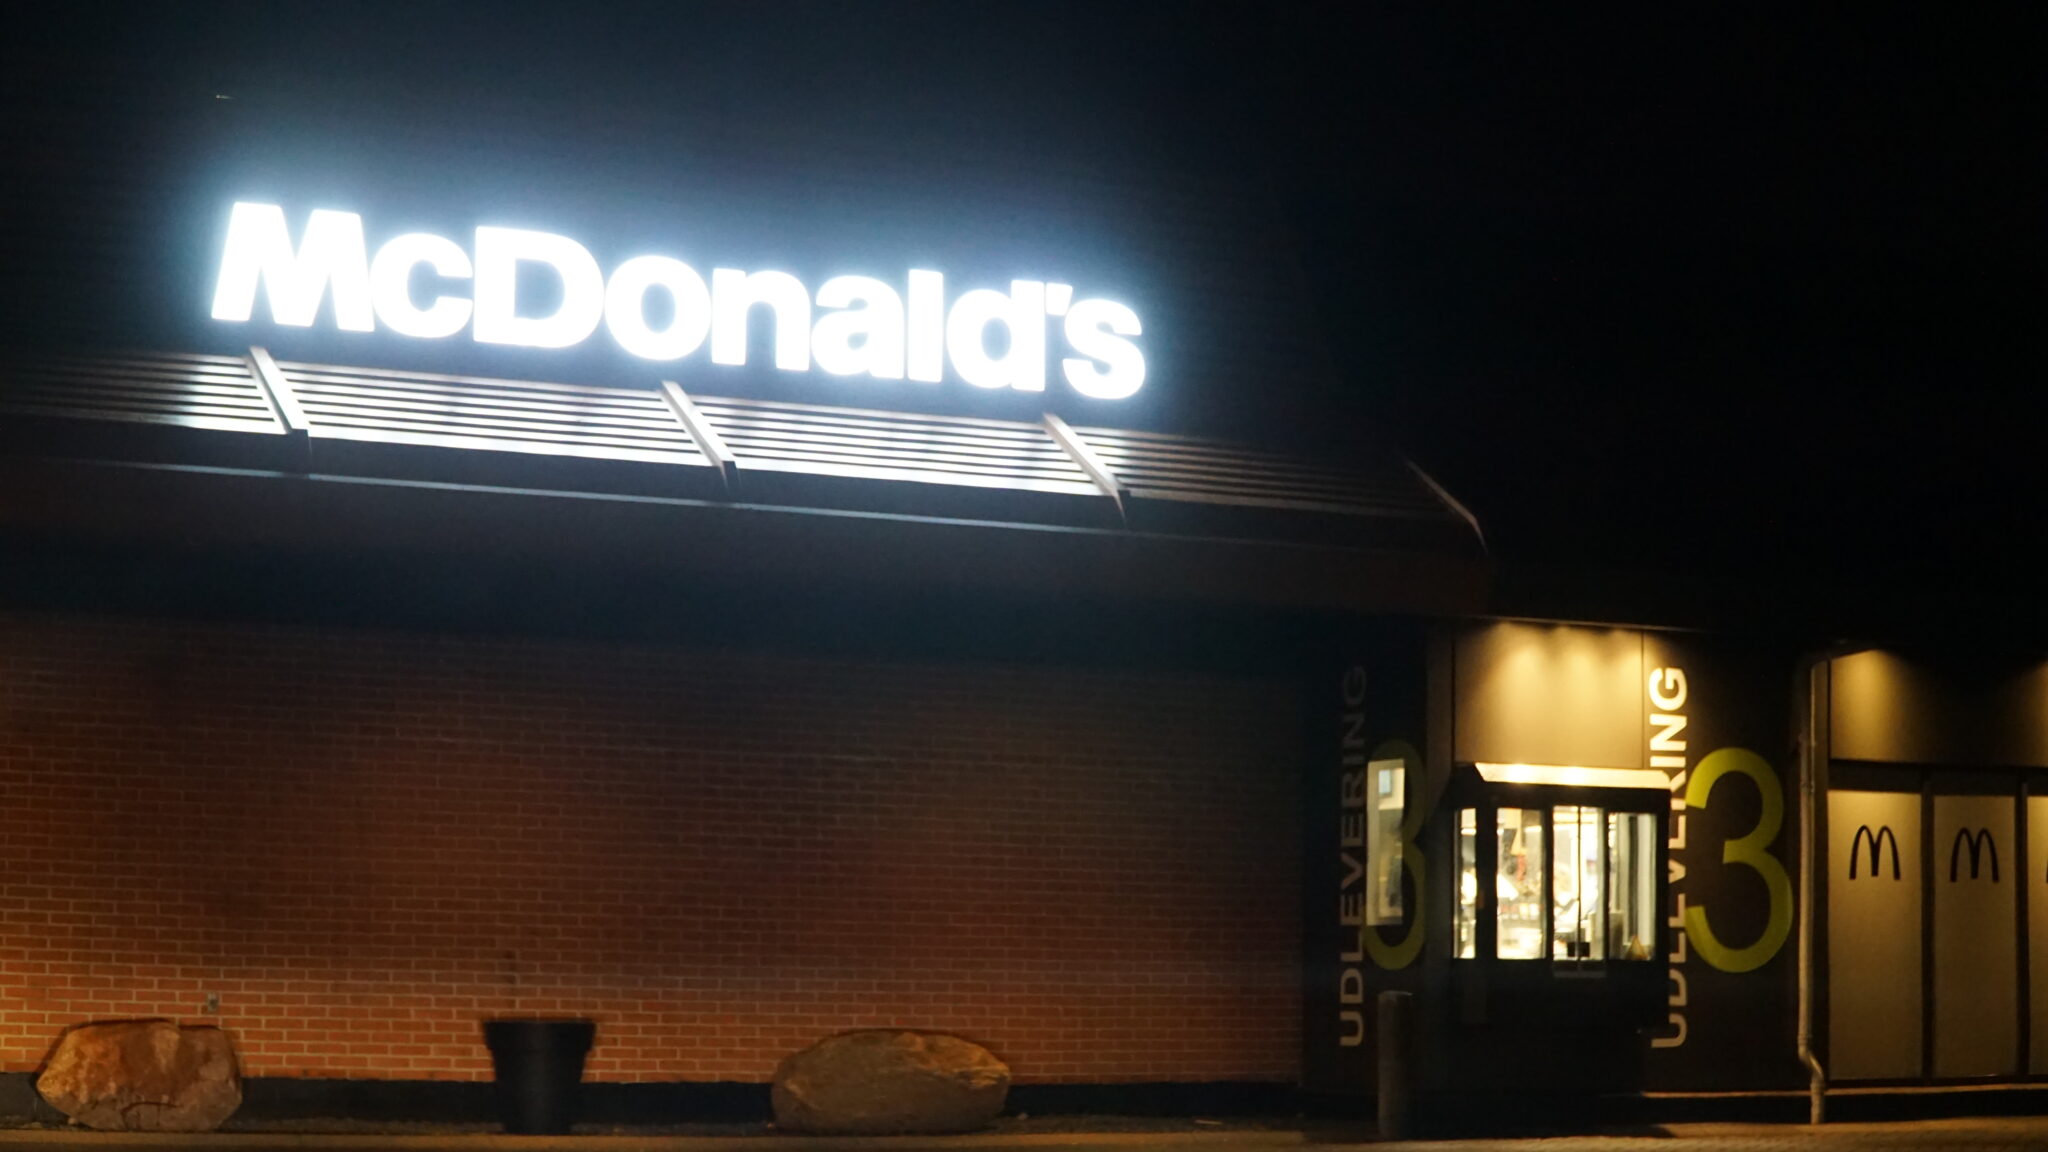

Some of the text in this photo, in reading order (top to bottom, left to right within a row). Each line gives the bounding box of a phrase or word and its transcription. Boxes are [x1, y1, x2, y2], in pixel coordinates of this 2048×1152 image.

[211, 201, 1146, 399] McDonald's
[1339, 664, 1367, 1047] UDLEVERING
[1685, 746, 1794, 974] 3
